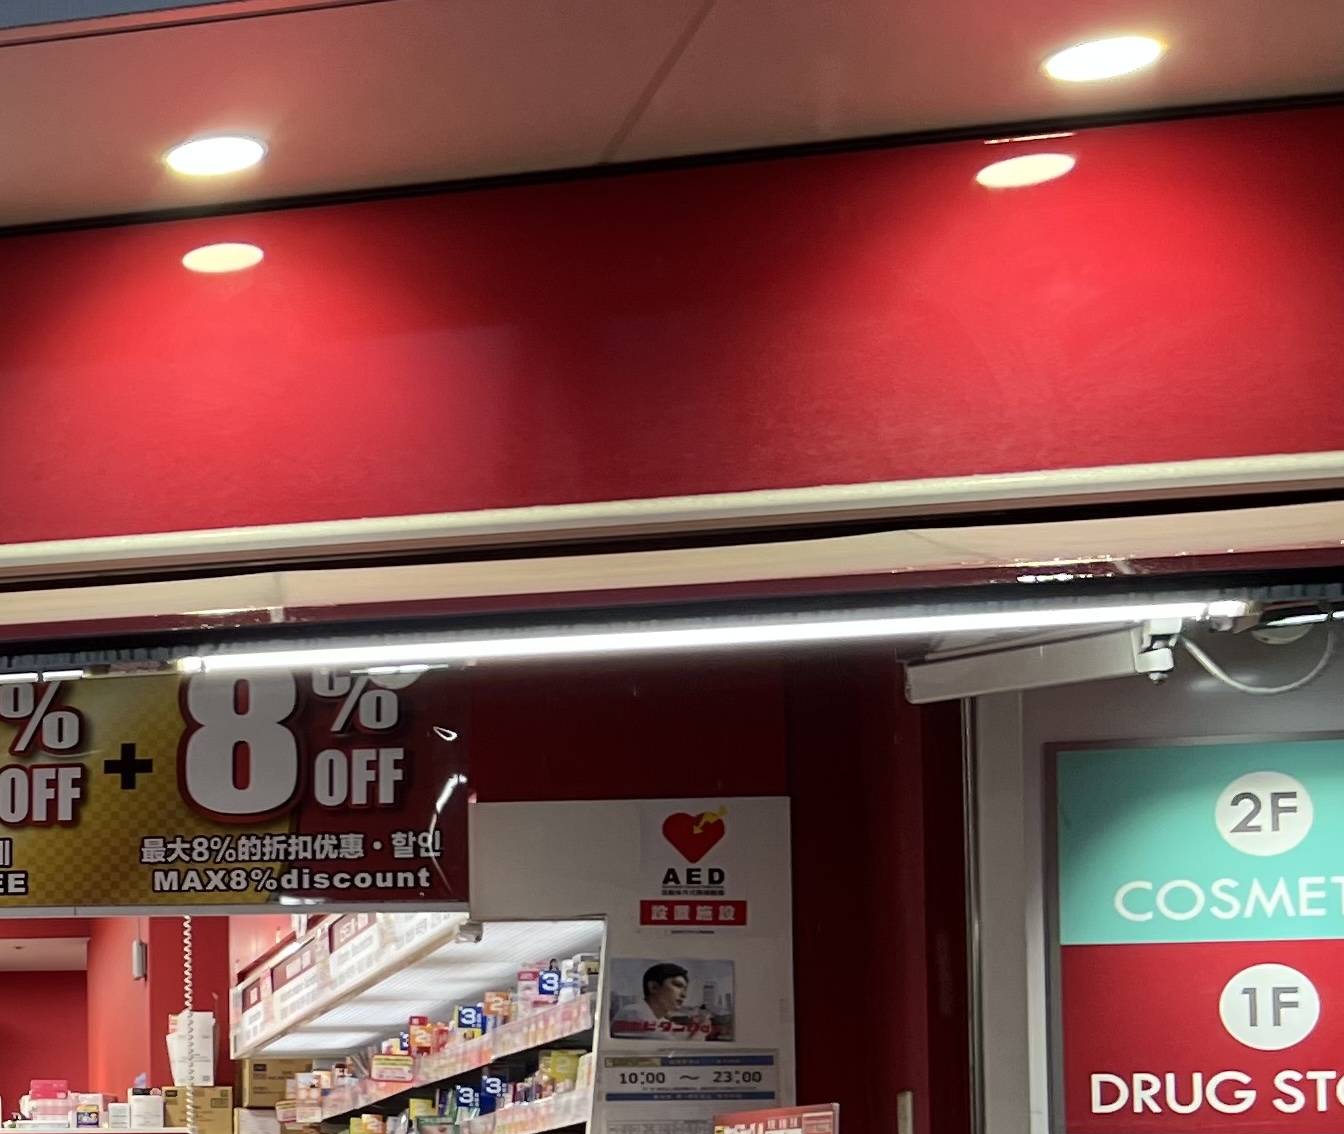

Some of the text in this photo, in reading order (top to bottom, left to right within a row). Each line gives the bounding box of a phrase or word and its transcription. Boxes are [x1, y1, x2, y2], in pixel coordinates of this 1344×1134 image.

[314, 748, 404, 809] OFF
[1230, 792, 1297, 833] 2F
[153, 867, 431, 893] MAX8%discount
[663, 868, 725, 884] AED
[1241, 986, 1299, 1027] 1F
[619, 1070, 762, 1084] 10:00 23:00
[1091, 1069, 1344, 1114] DRUG ST
